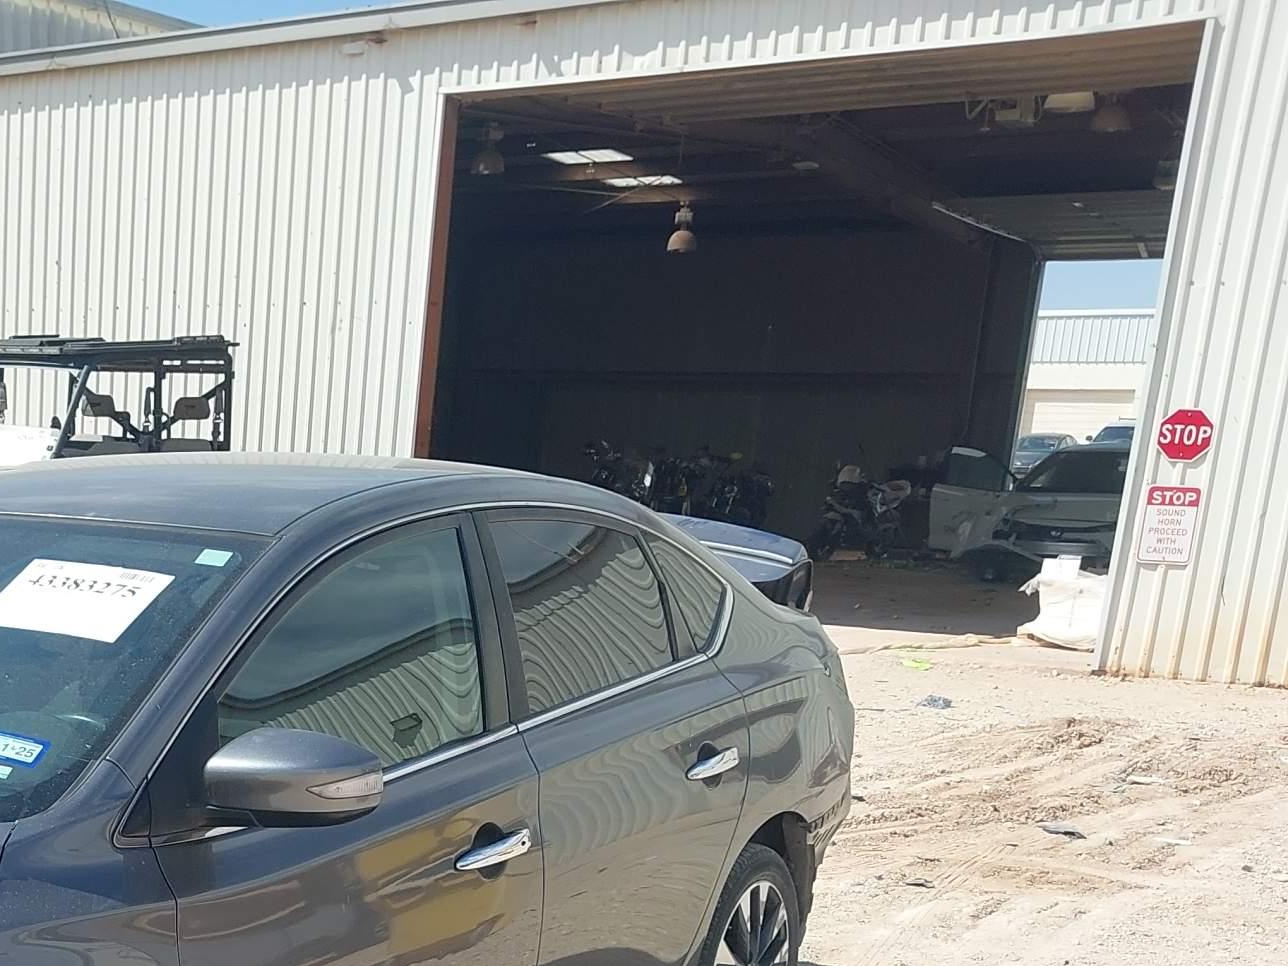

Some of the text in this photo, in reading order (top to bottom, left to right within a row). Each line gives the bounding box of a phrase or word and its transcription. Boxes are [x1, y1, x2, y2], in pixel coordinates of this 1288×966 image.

[1159, 423, 1212, 446] STOP
[1151, 490, 1197, 505] STOP
[1156, 508, 1186, 517] SOUND
[1157, 518, 1182, 527] HORN
[1148, 527, 1188, 536] PROCEED
[1156, 537, 1177, 545] WITH
[1146, 546, 1184, 555] CAUTION
[29, 574, 142, 598] 43383275
